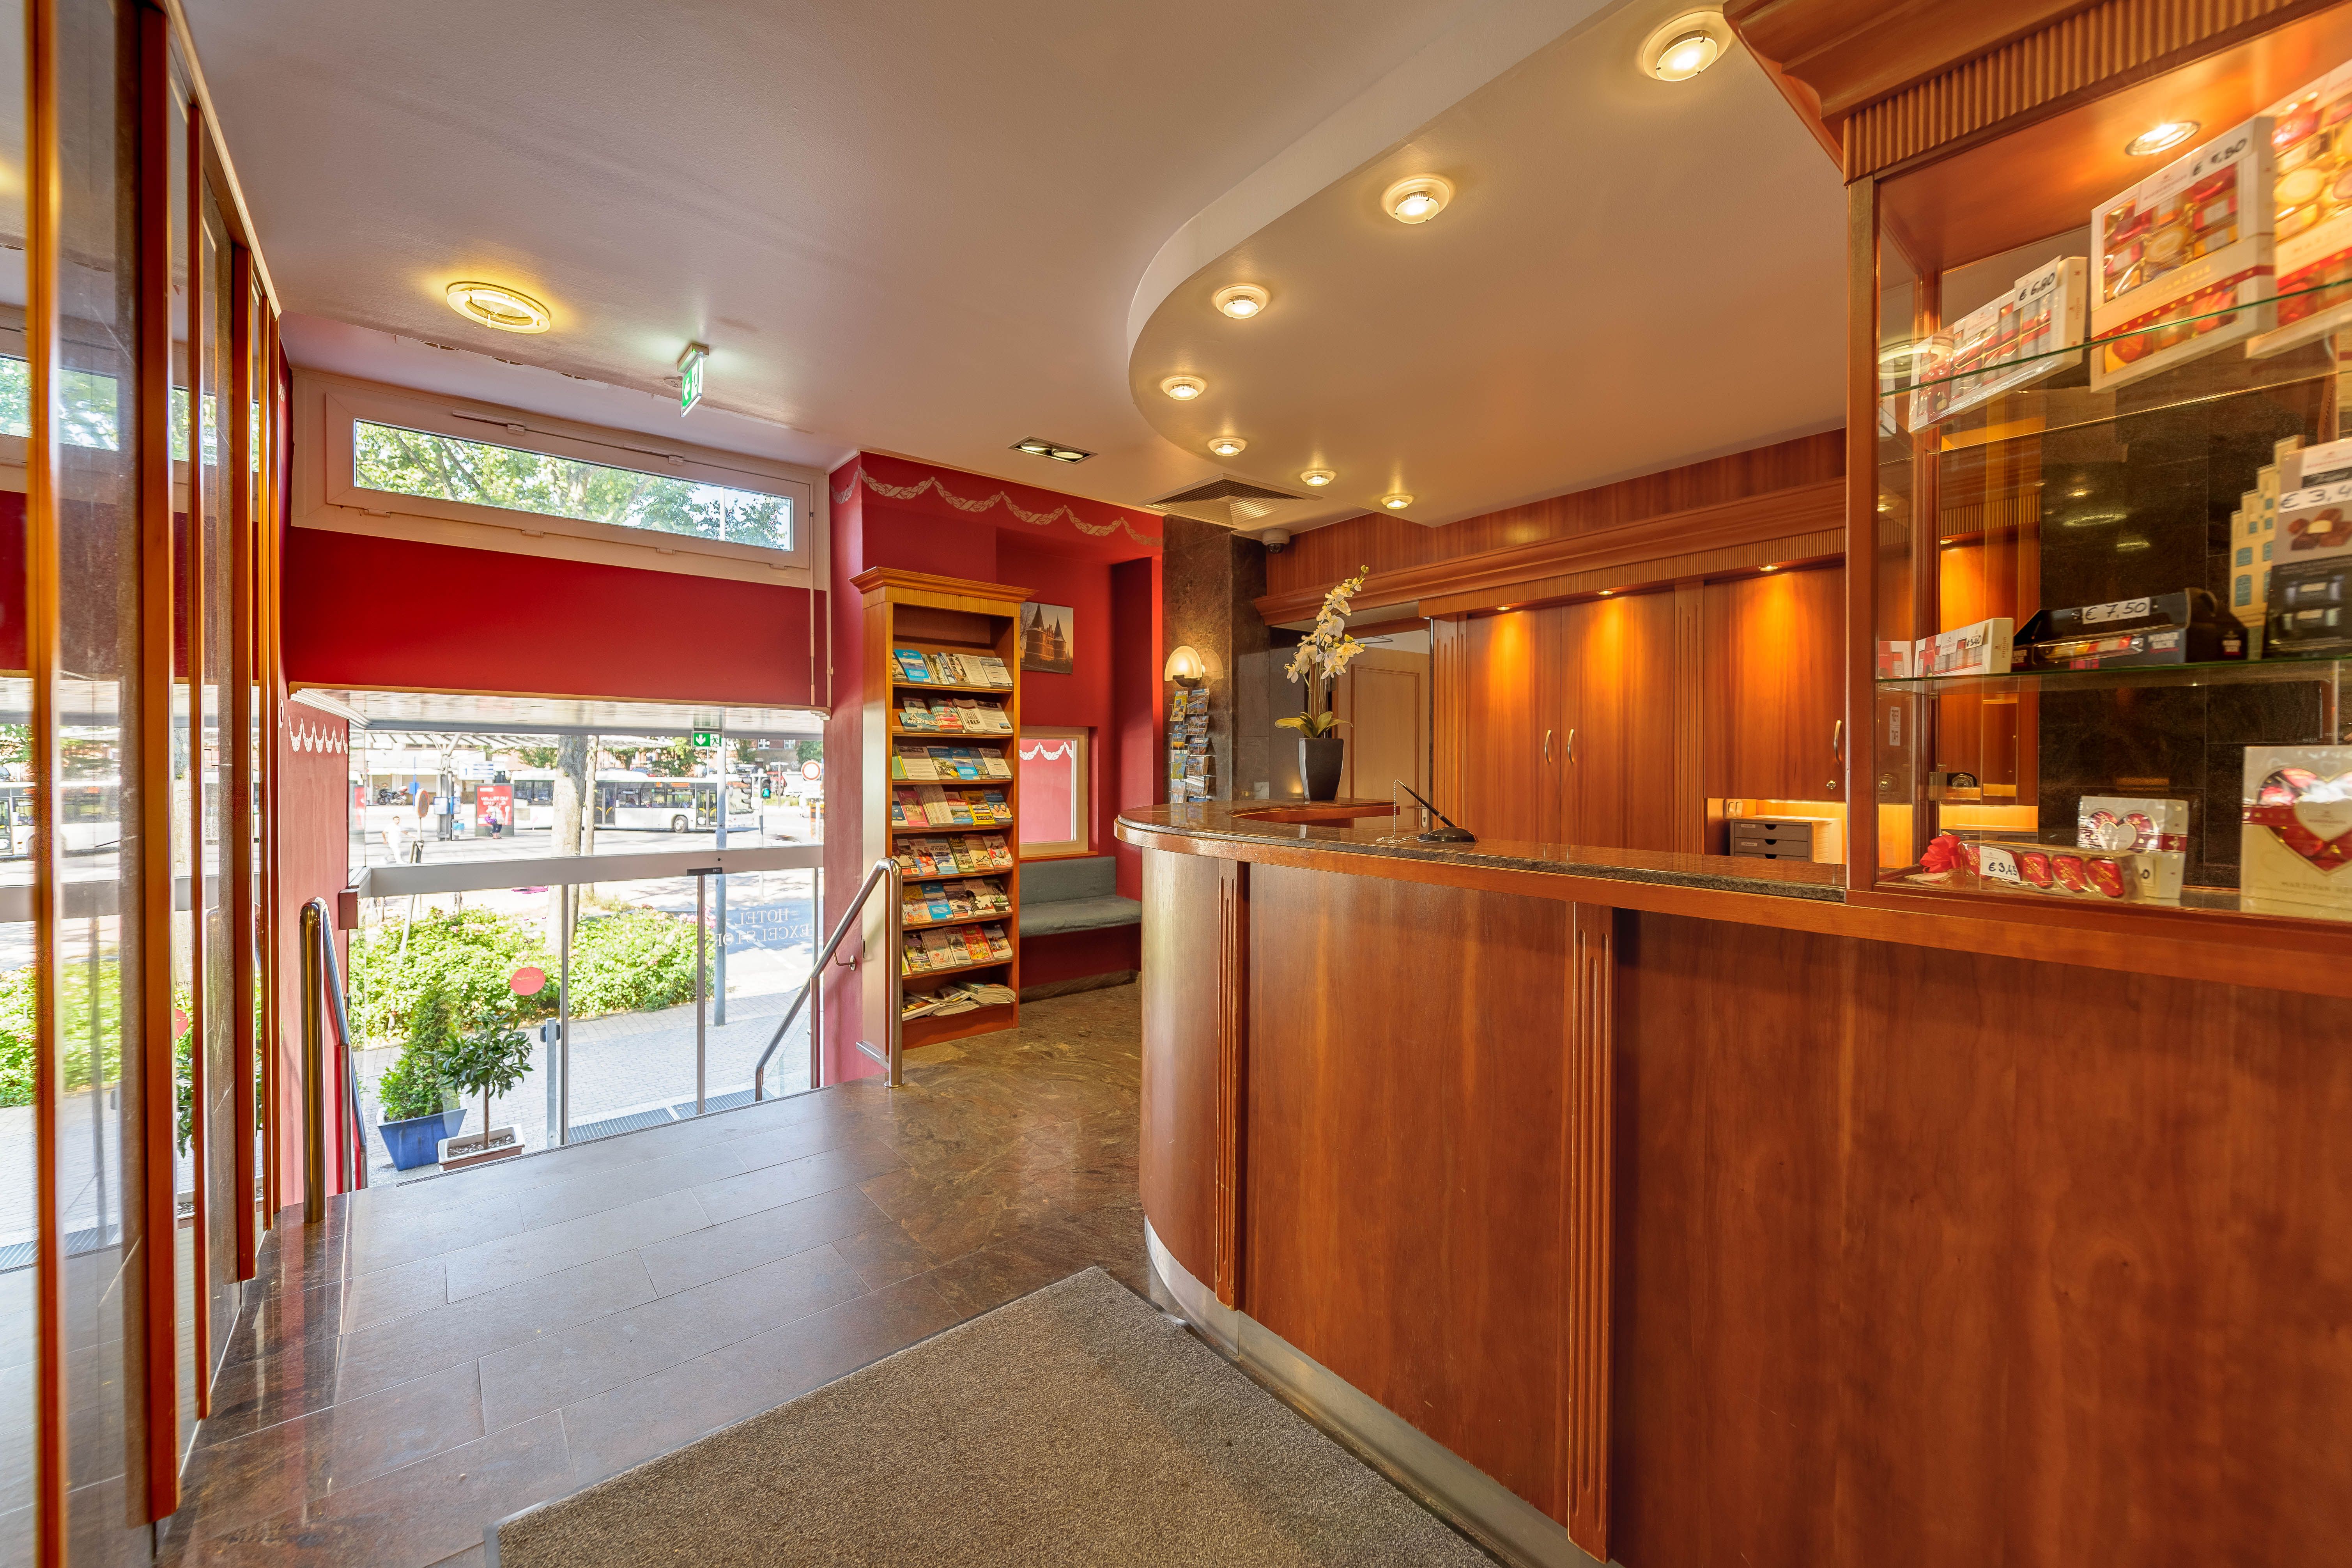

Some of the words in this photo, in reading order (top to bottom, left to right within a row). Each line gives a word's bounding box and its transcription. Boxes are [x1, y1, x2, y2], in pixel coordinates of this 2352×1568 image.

[2280, 492, 2300, 509] €
[2086, 607, 2098, 621] €
[2105, 602, 2147, 619] 7,50
[1989, 862, 1996, 872] €
[1998, 862, 2018, 876] 3,45
